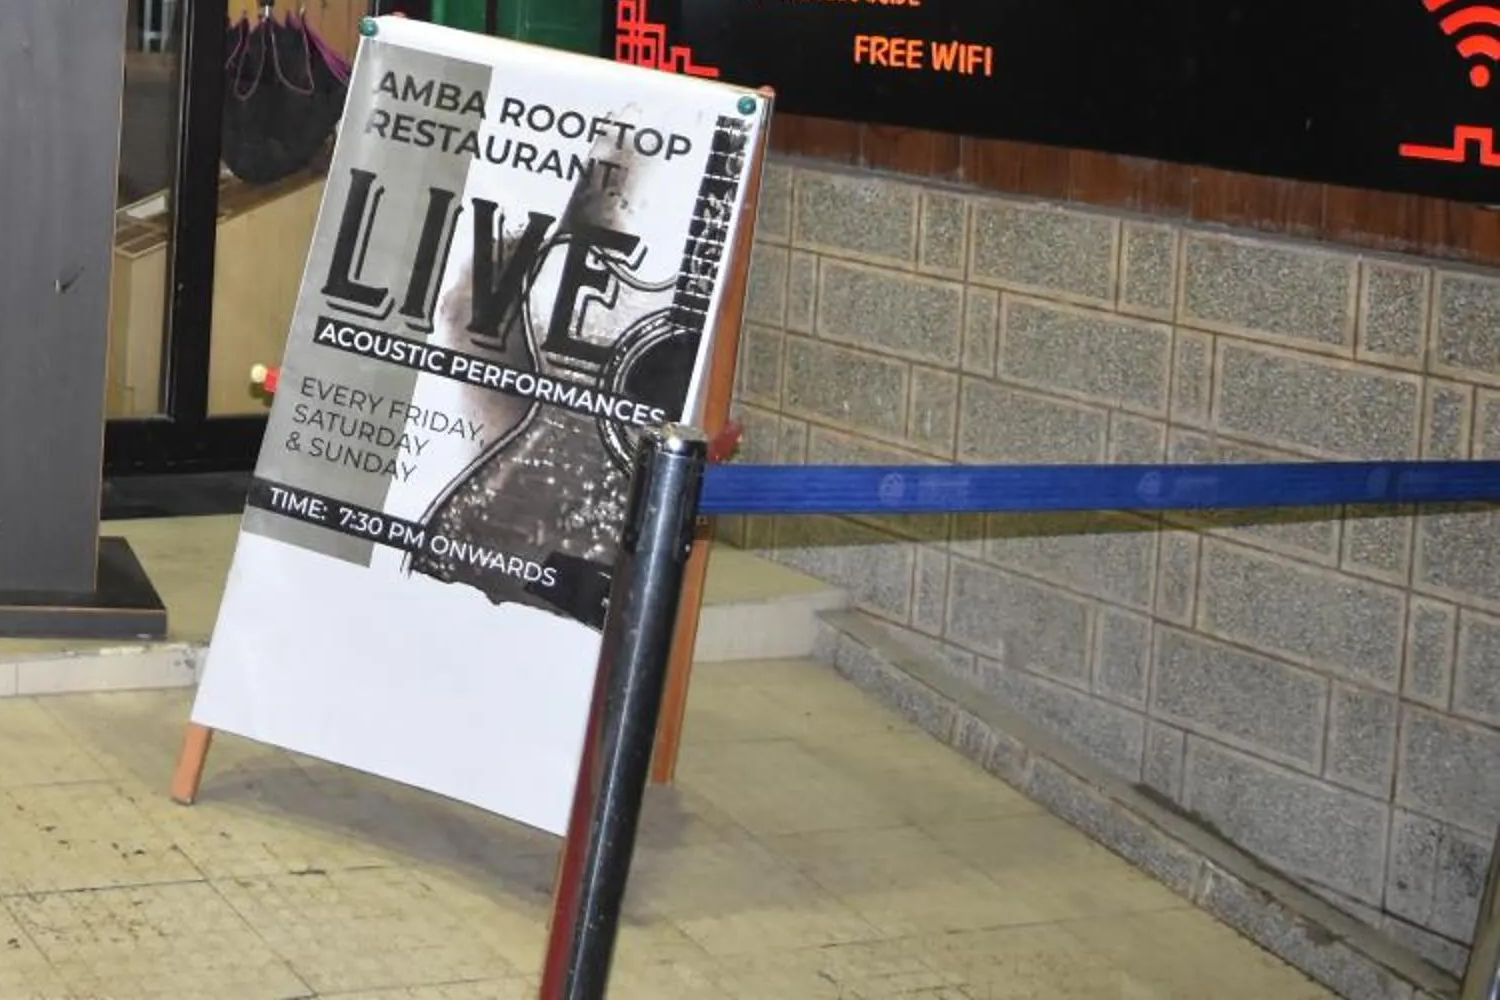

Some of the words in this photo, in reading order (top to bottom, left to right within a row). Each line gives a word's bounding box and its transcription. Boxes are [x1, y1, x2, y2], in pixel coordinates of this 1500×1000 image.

[854, 34, 924, 70] FREE
[931, 41, 993, 78] WIFI
[364, 107, 624, 187] RESTAURANT
[373, 69, 488, 120] AMBA
[499, 97, 693, 161] ROOFTOP
[320, 166, 648, 385] LIVE
[300, 376, 384, 415] EVERY
[389, 399, 485, 446] FRIDAY,
[319, 322, 446, 372] ACOUSTIC
[450, 355, 666, 425] PERFORMANCES
[285, 431, 301, 452] &
[308, 437, 417, 482] SUNDAY
[292, 403, 430, 456] SATURDAY
[270, 486, 328, 521] TIME:
[338, 506, 383, 536] 7:30
[387, 521, 426, 549] PM
[430, 535, 558, 588] ONWARDS
